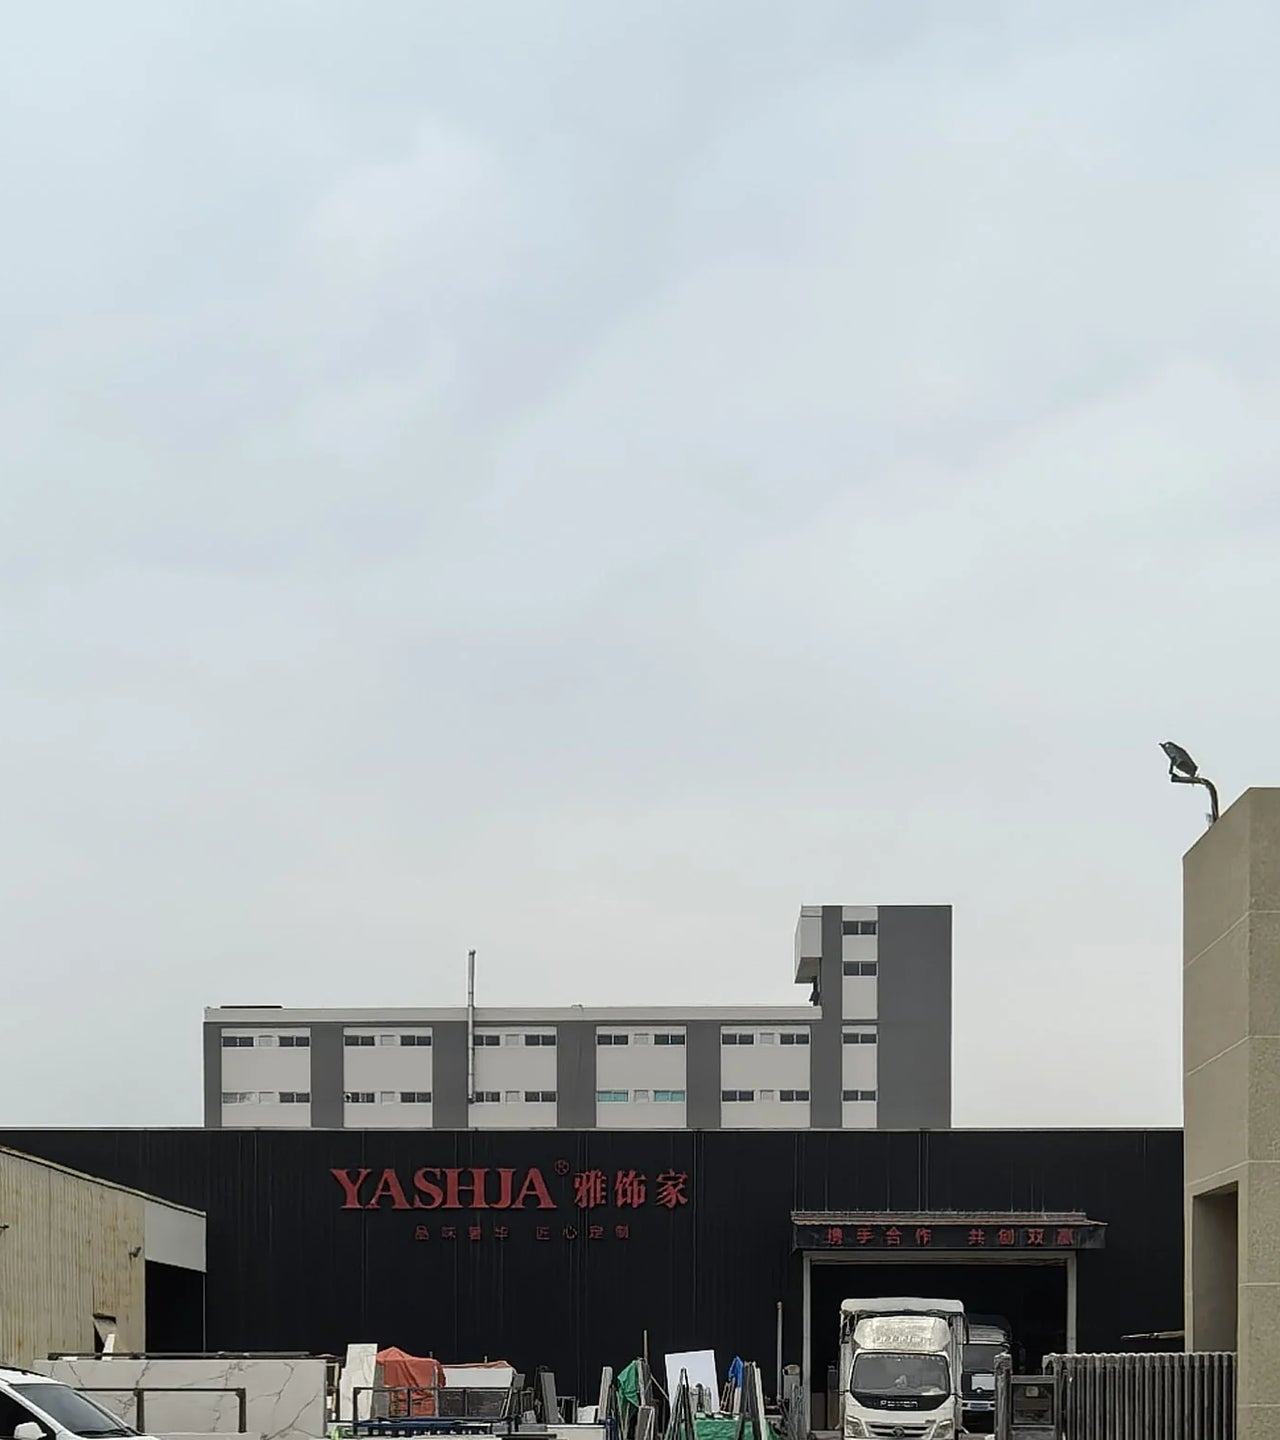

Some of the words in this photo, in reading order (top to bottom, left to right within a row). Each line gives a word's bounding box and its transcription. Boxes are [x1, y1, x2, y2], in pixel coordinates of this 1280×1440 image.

[329, 1167, 558, 1210] YASHJA
[573, 1168, 690, 1210] 雅饰家
[826, 1227, 932, 1245] 携手合作
[968, 1227, 1074, 1245] 共创双赢
